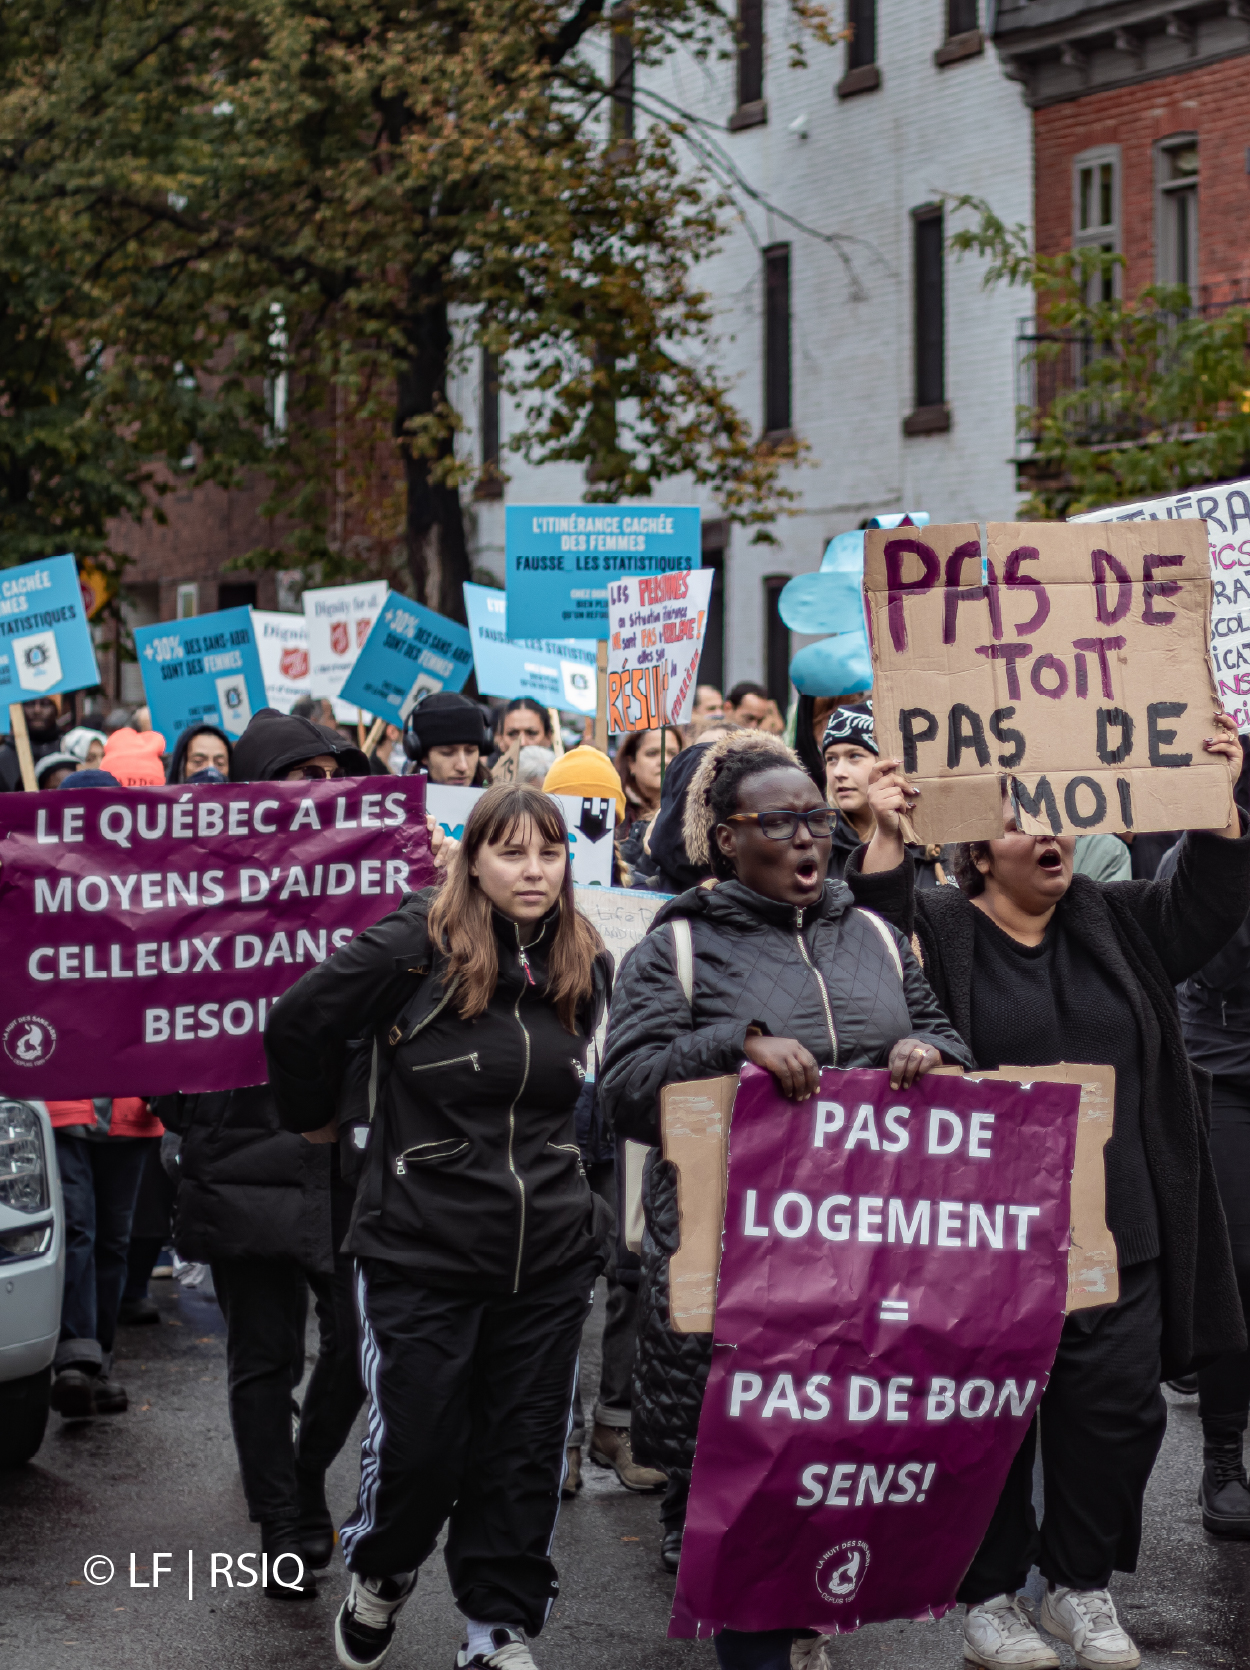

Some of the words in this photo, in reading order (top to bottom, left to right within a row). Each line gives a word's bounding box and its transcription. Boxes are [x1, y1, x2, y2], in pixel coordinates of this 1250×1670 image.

[532, 513, 620, 534] L'ITINÉRANCE
[622, 514, 674, 534] CACHÉE
[560, 535, 587, 551] DES
[589, 535, 646, 551] FEMMES
[575, 555, 600, 571] LES
[602, 555, 693, 573] STATISTIQUES
[610, 585, 629, 605] LES
[884, 538, 1050, 653] PAS
[1090, 548, 1186, 627] DE
[975, 635, 1126, 701] TOIT
[899, 701, 1027, 773] PAS
[1096, 701, 1193, 767] DE
[36, 807, 85, 844] LE
[99, 793, 280, 848] QUÉBEC
[289, 798, 321, 831] A
[335, 792, 407, 829] LES
[1011, 774, 1133, 836] MOI
[34, 869, 226, 914] MOYENS
[240, 860, 412, 903] D'AIDER
[28, 936, 221, 981] CELLEUX
[235, 929, 354, 969] DANS
[145, 997, 283, 1044] BESOI
[814, 1101, 911, 1153] PAS
[927, 1109, 995, 1158] DE
[744, 1190, 1040, 1251] LOGEMENT
[729, 1372, 831, 1420] PAS
[848, 1375, 913, 1421] DE
[926, 1377, 1036, 1421] BON
[796, 1463, 936, 1506] SENS!
[842, 1540, 856, 1549] DES
